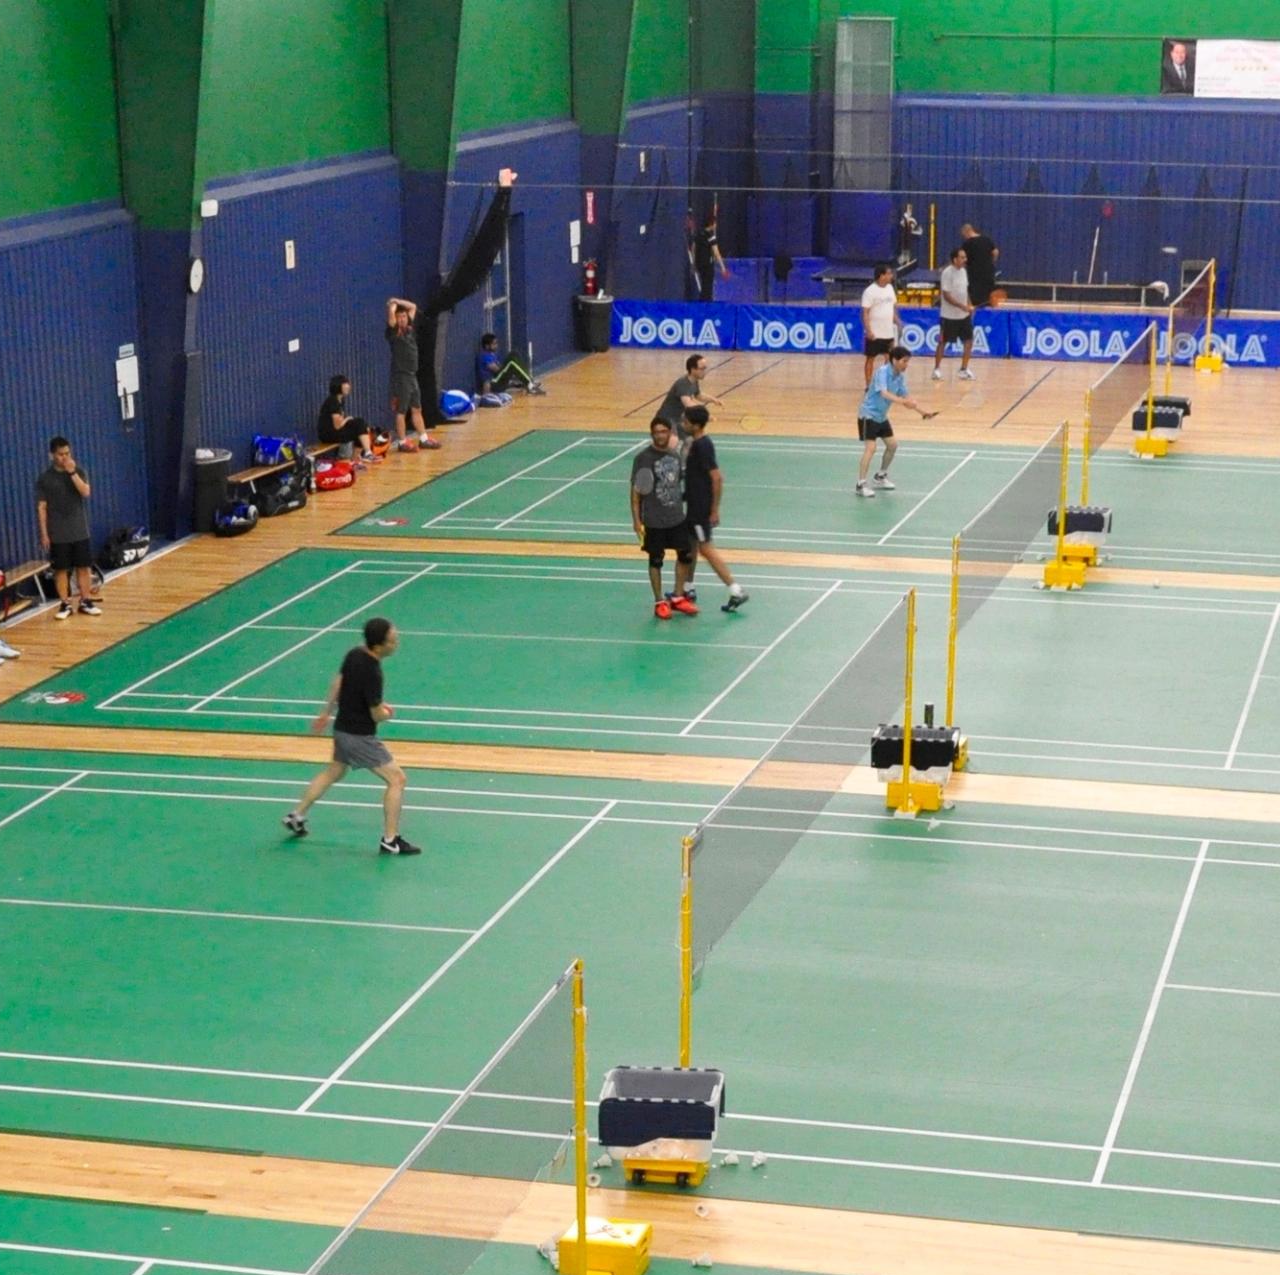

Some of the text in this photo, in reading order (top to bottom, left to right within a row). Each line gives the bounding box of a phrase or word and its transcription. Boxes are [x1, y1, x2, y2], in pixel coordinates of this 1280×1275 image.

[620, 316, 720, 345] JOOLA
[750, 320, 851, 350] JOOLA
[896, 323, 990, 353] OOA
[1023, 327, 1126, 357] JOOLA
